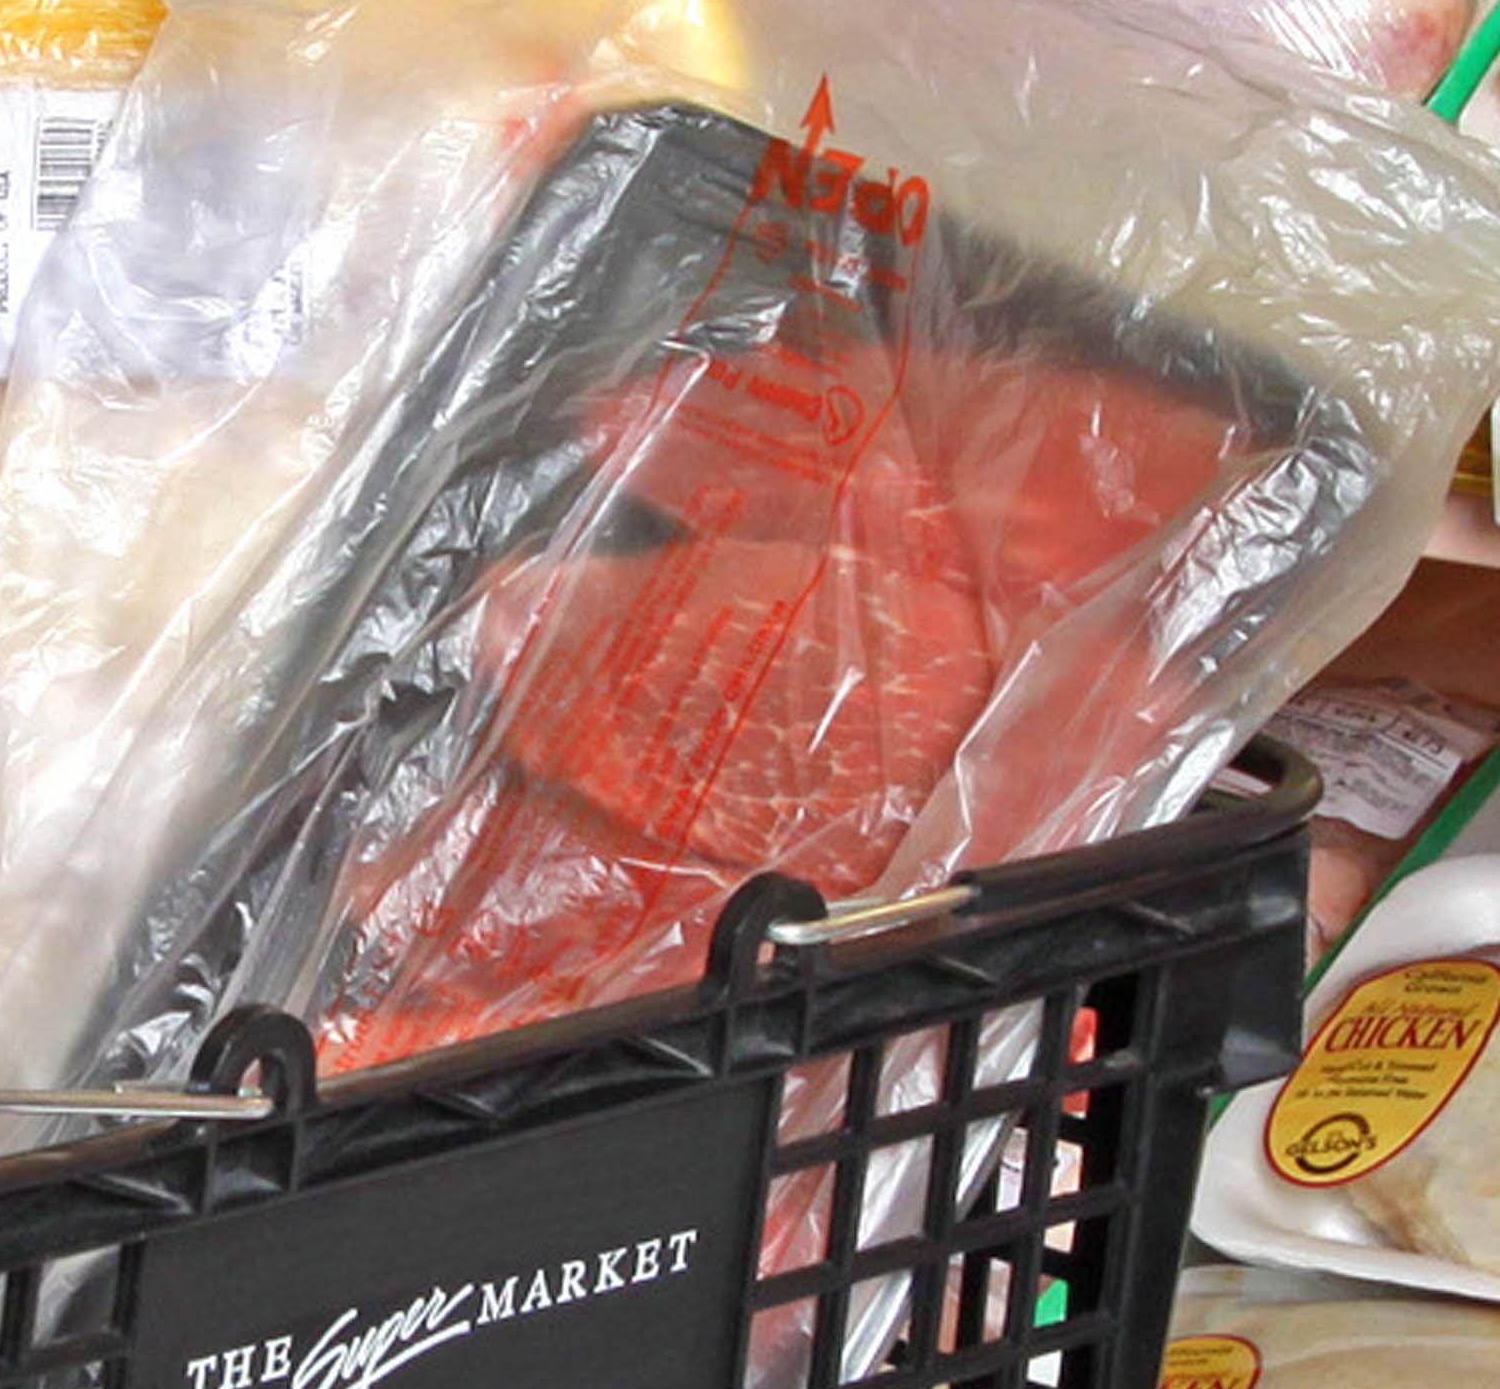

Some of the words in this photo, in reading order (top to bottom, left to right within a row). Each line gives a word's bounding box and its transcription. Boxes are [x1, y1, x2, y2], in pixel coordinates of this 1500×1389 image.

[748, 137, 932, 248] OPEN
[1325, 1015, 1483, 1053] CHICKEN
[475, 1228, 698, 1326] MARKET
